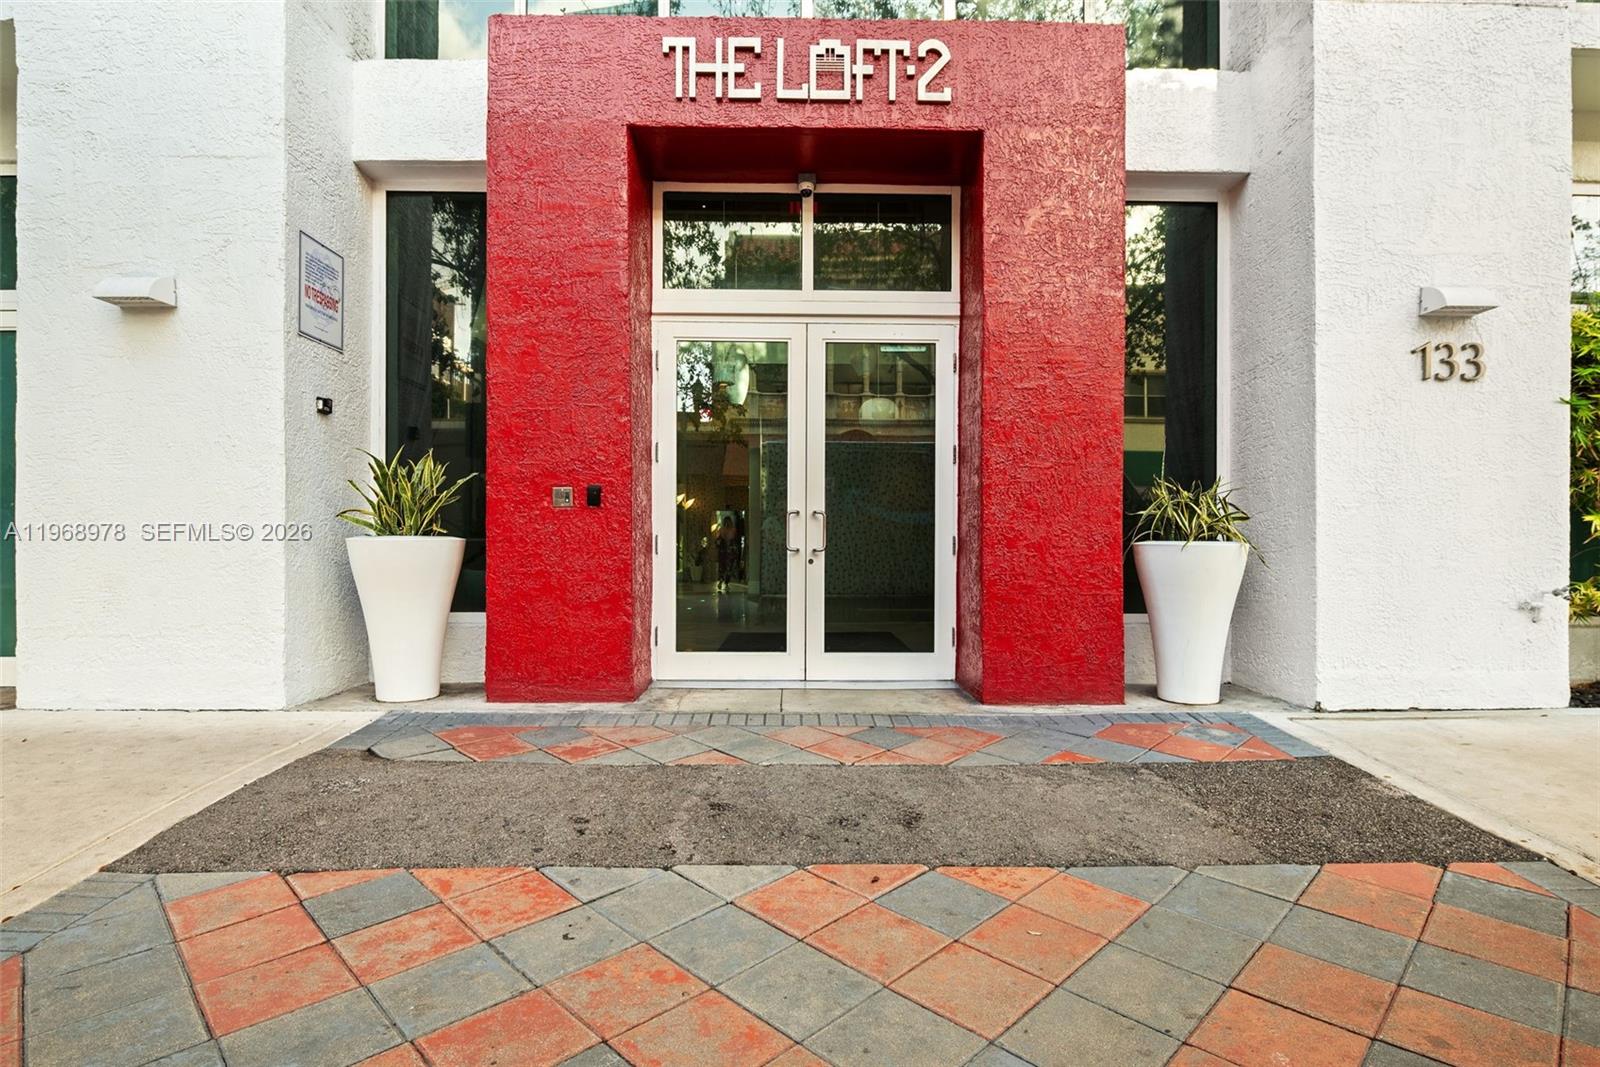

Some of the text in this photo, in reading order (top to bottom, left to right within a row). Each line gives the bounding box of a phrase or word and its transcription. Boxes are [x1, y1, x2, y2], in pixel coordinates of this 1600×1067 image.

[662, 36, 762, 101] THE
[304, 284, 311, 299] NO
[311, 287, 339, 313] TRESPASSING
[1410, 341, 1487, 383] 133
